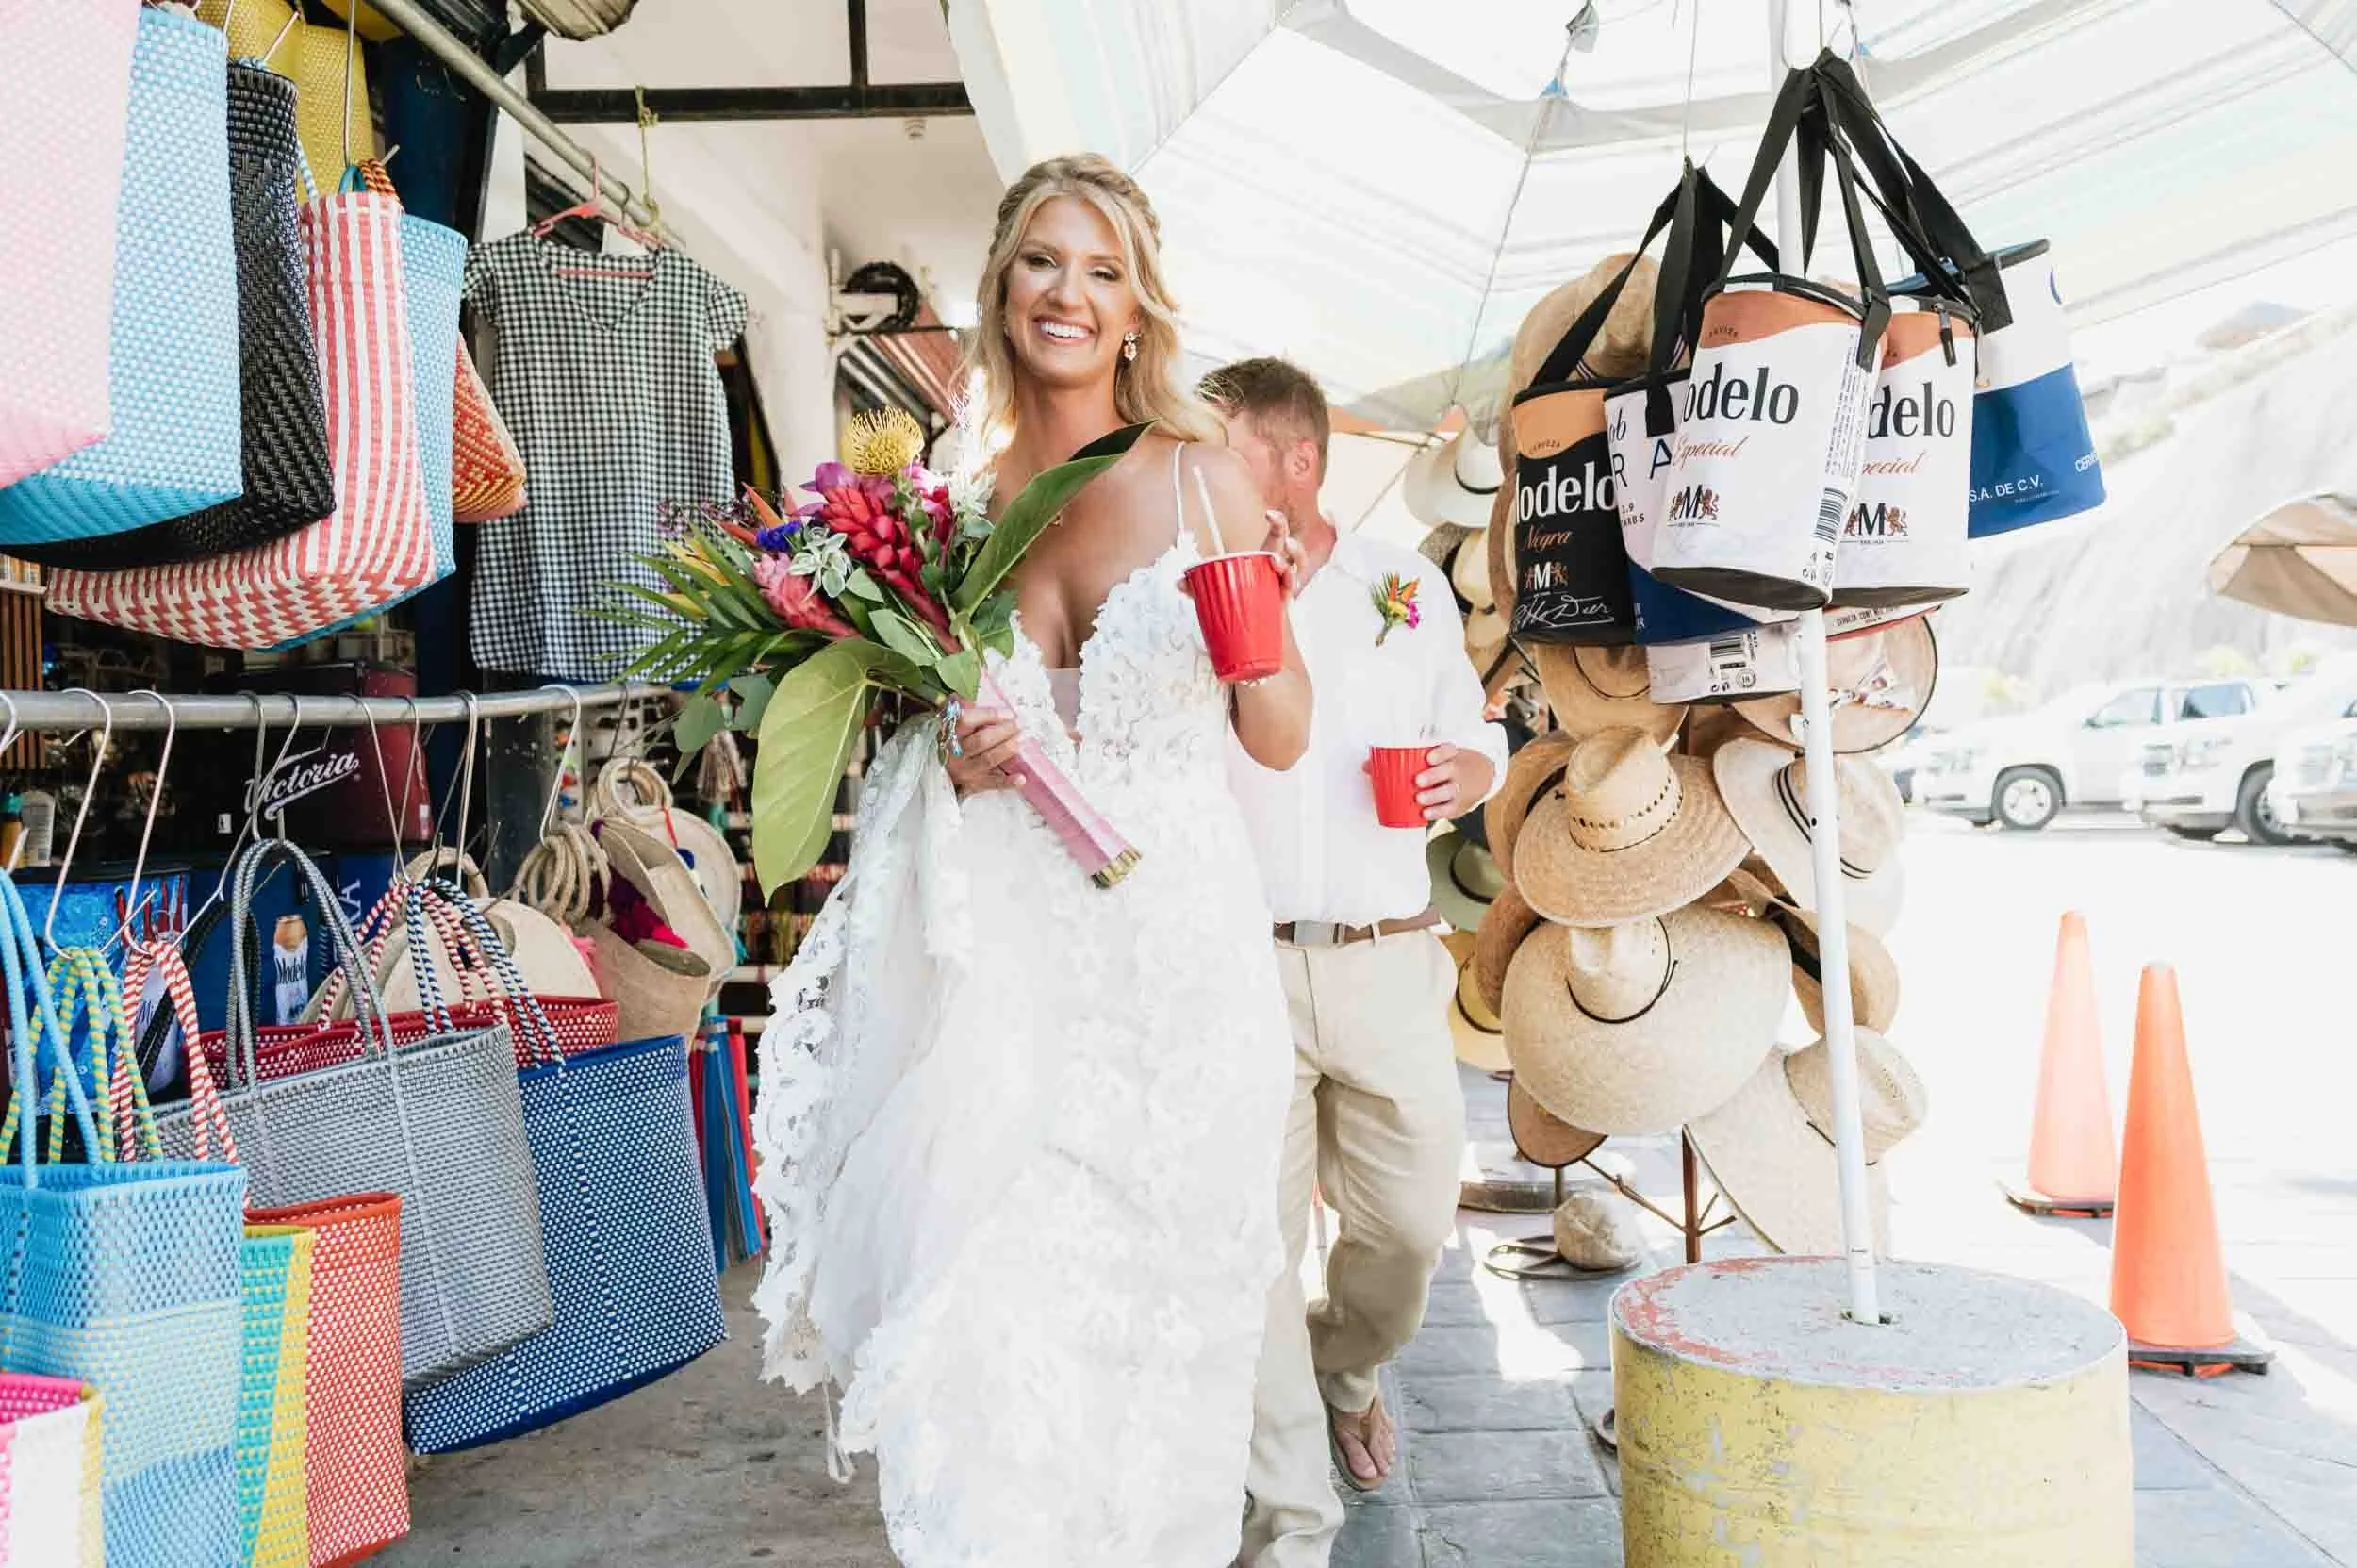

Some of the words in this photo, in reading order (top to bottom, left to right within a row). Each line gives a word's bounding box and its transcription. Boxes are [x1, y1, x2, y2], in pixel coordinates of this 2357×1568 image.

[1683, 362, 1799, 424] odelo
[1868, 381, 1955, 439] delo
[1516, 461, 1618, 525] odelo
[1995, 481, 2015, 497] DE
[2017, 474, 2044, 491] C.V.
[1858, 502, 1887, 536] M
[245, 746, 360, 818] Victoria
